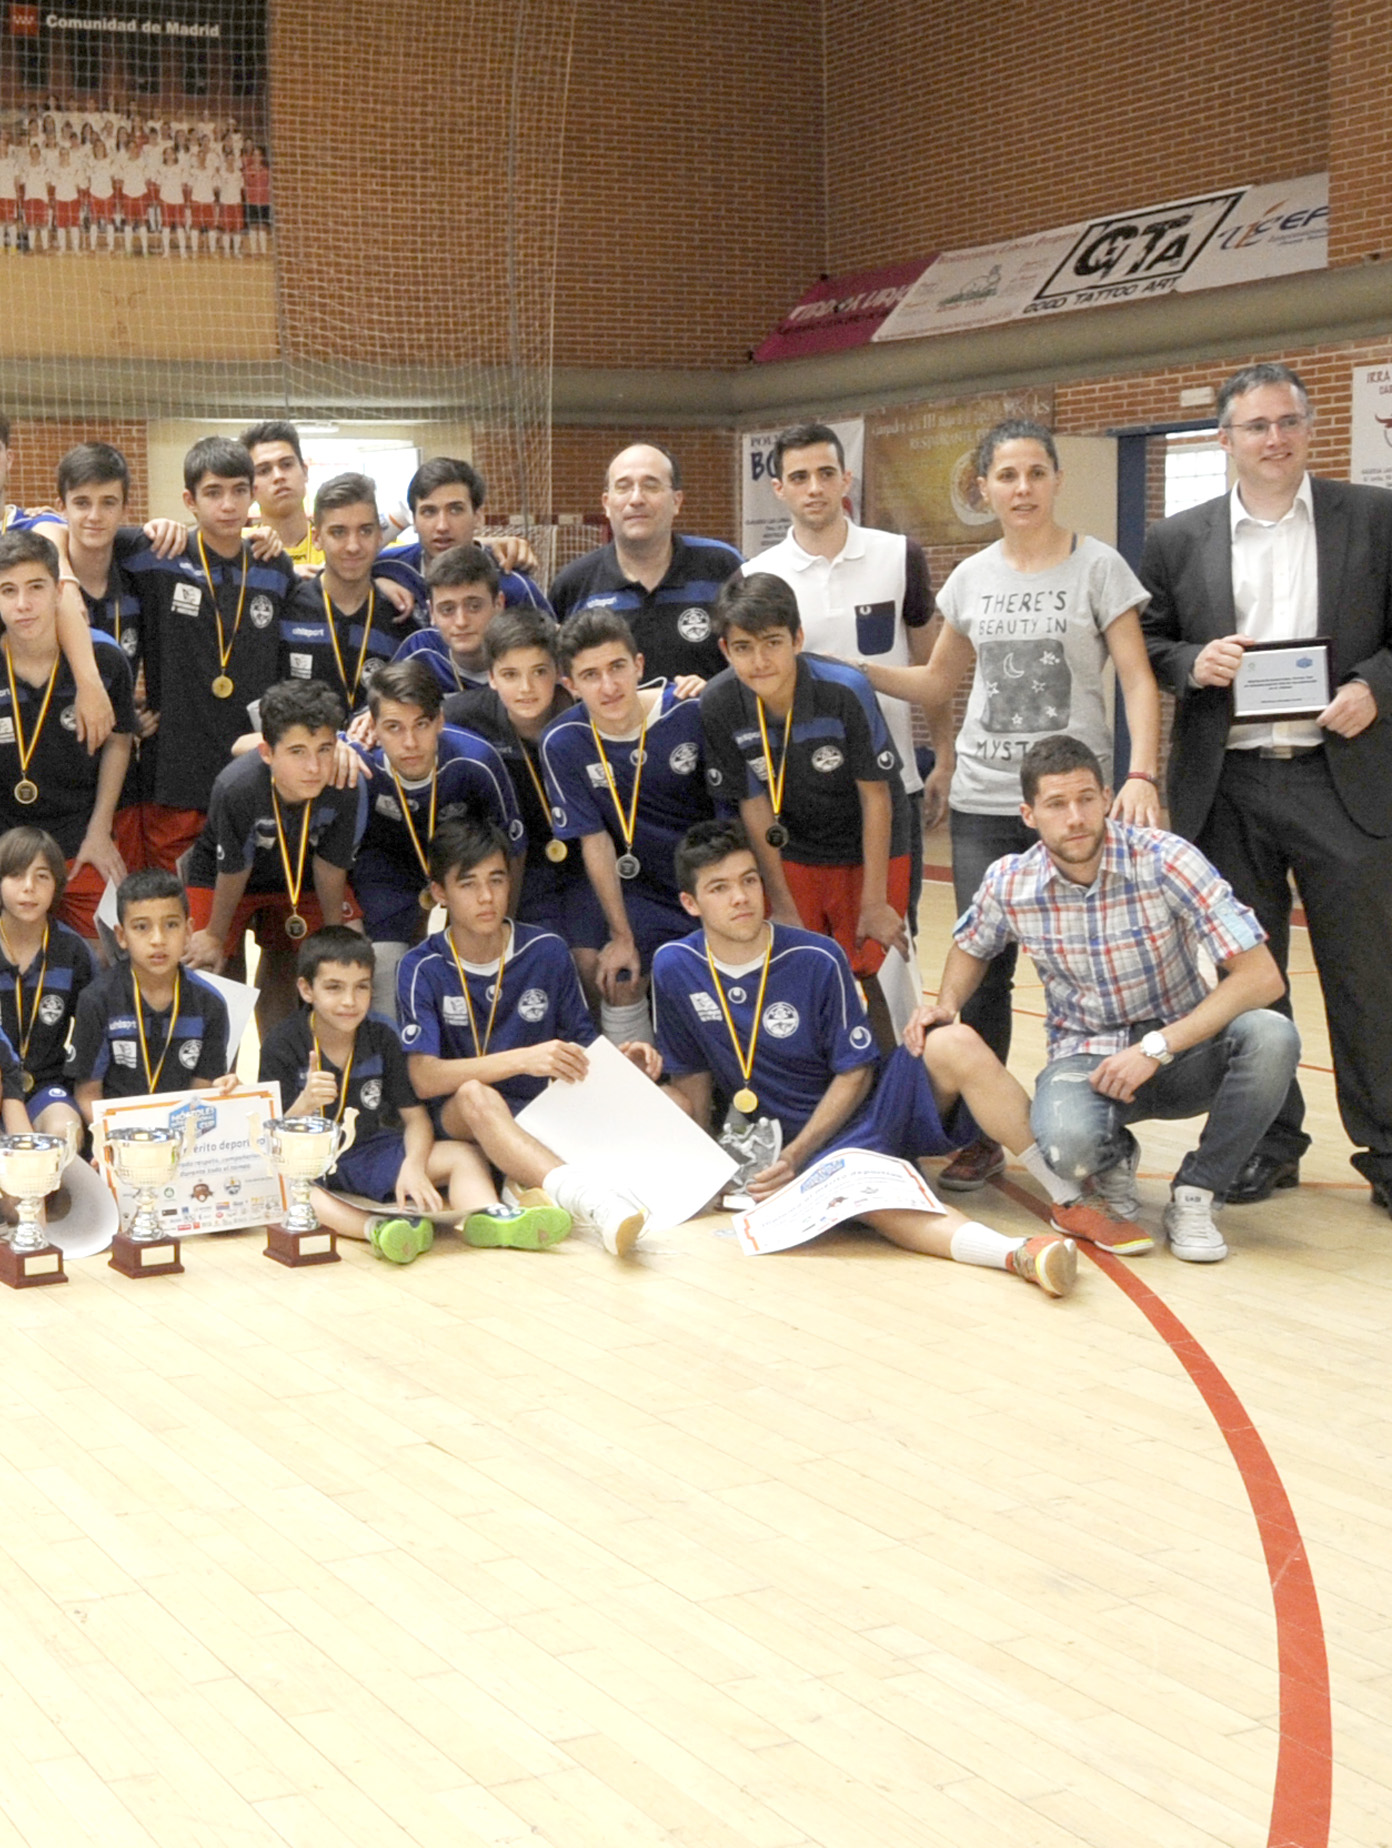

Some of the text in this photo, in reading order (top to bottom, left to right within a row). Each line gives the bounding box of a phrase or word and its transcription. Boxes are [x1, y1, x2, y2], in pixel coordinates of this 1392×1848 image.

[46, 14, 220, 37] Comunidad de Madrid
[1072, 284, 1138, 306] TATTOO
[1141, 275, 1182, 294] ART
[981, 590, 1068, 615] THERE'S
[978, 616, 1068, 636] BEAUTY IN
